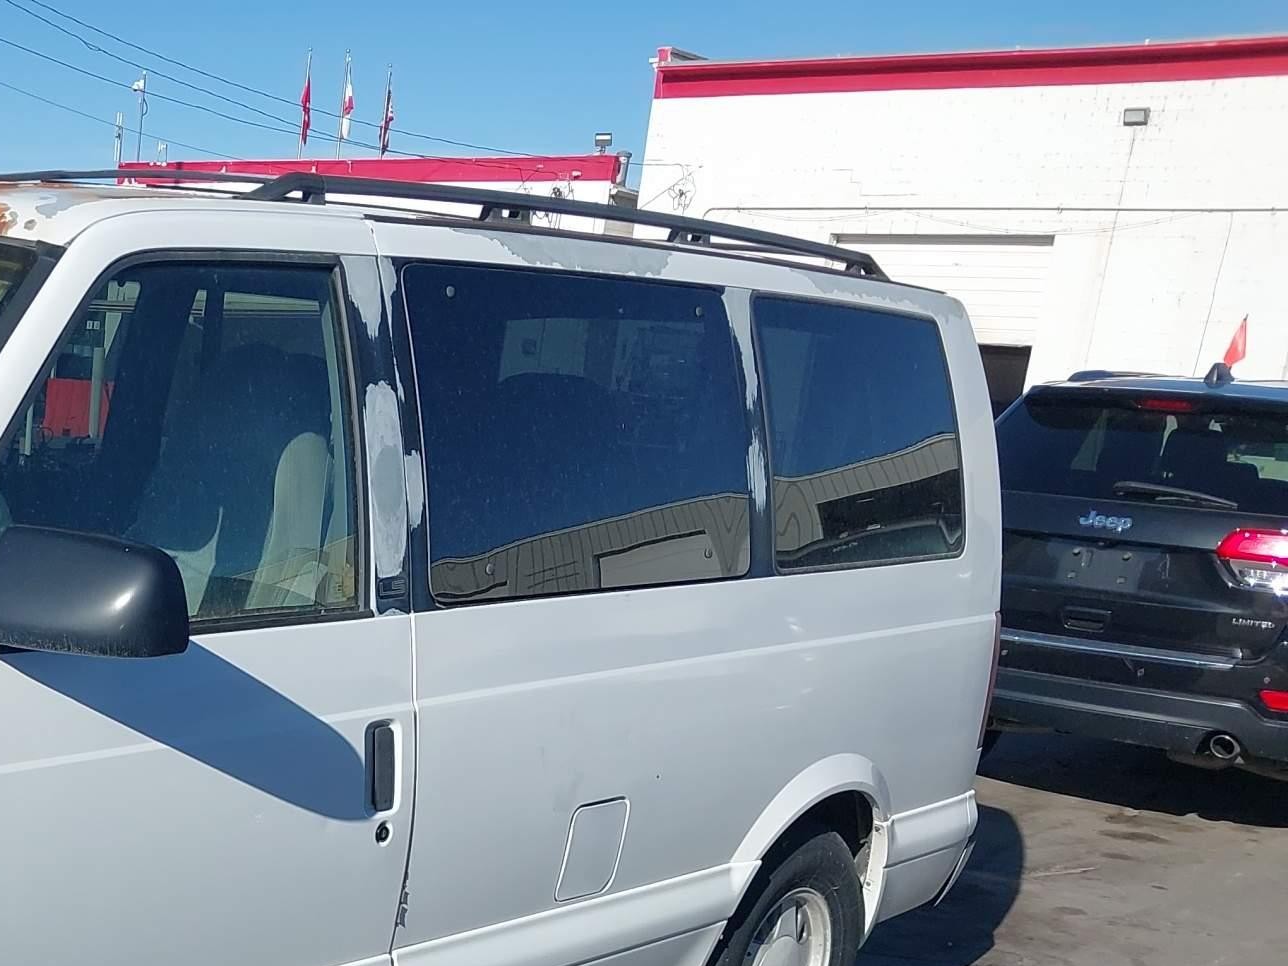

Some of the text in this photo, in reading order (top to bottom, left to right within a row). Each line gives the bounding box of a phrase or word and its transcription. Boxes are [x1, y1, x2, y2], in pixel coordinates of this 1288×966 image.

[1079, 507, 1133, 533] Jeep
[379, 580, 406, 596] LS
[1231, 617, 1276, 630] LIMITED
